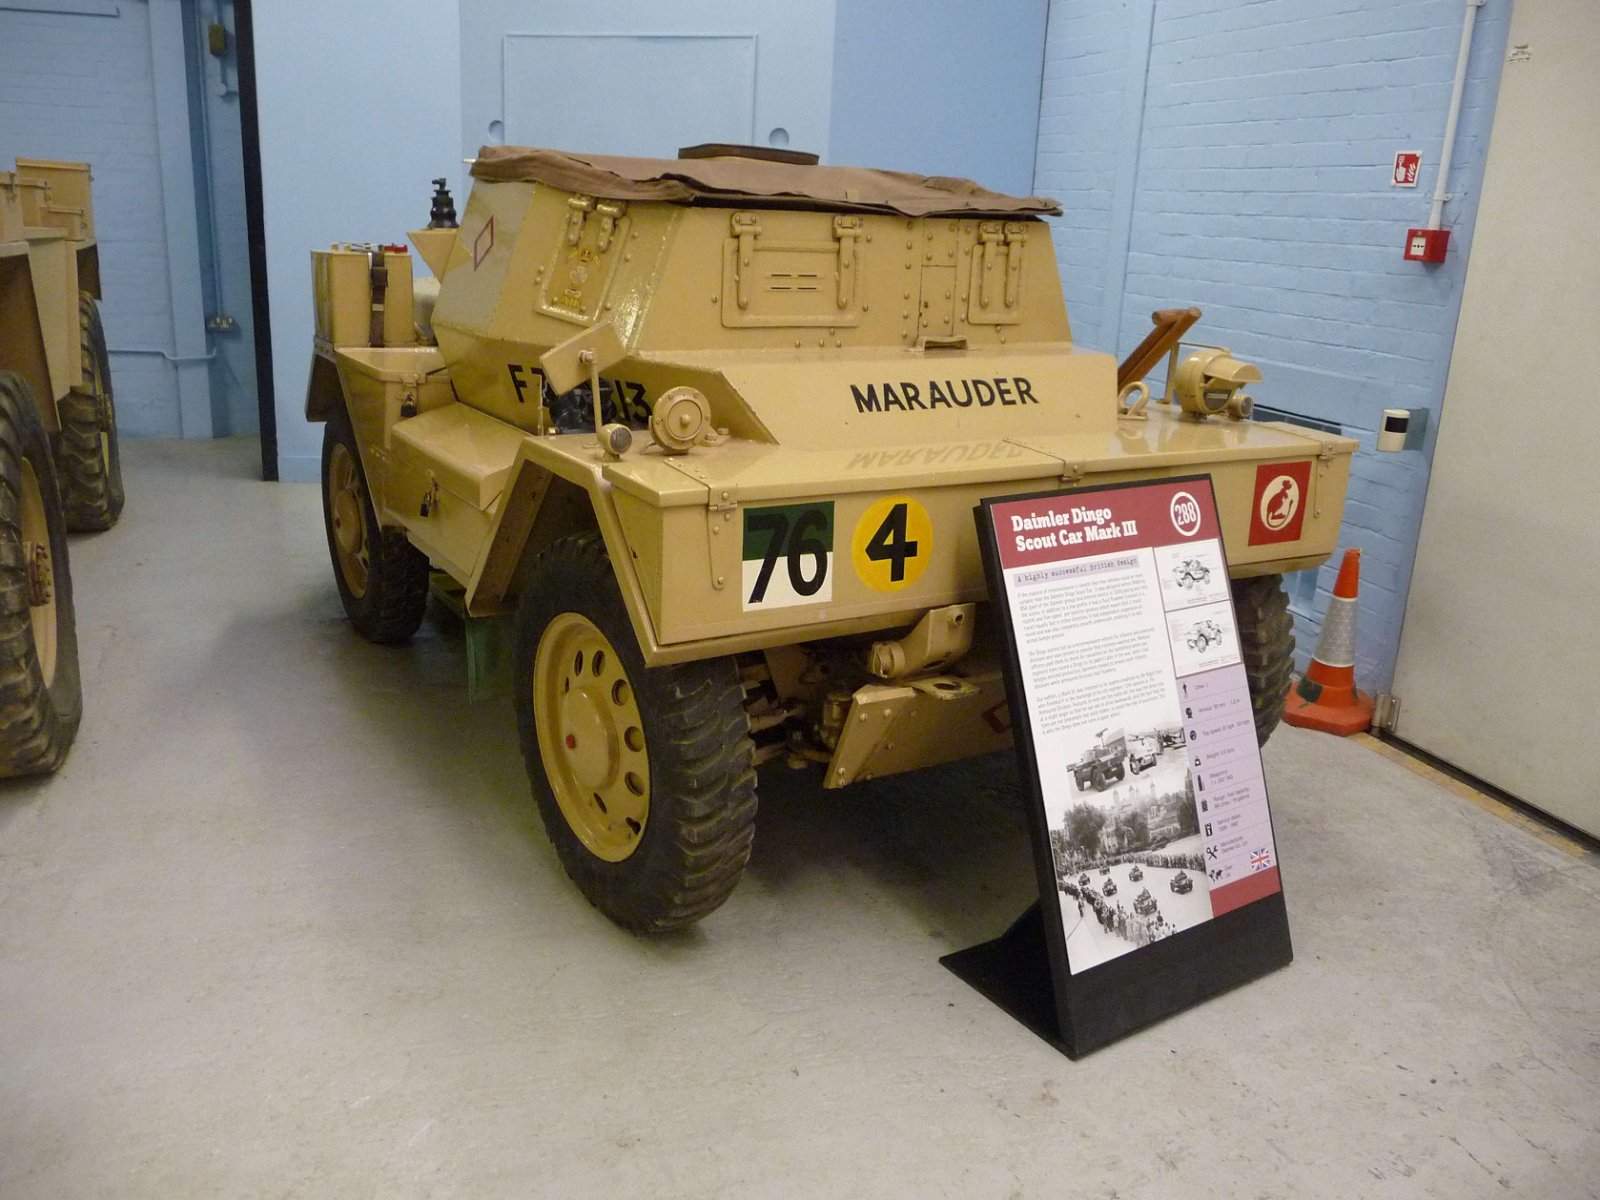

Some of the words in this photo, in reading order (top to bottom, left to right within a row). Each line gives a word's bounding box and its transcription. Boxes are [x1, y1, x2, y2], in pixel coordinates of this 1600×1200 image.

[850, 377, 1039, 413] MARAUDER
[1011, 510, 1070, 532] Daimler
[1070, 506, 1112, 525] Dingo
[1175, 501, 1197, 525] 288
[865, 503, 918, 582] 4
[1015, 532, 1058, 552] Scout
[1059, 529, 1083, 545] Car
[1084, 522, 1121, 542] Mark
[1121, 520, 1138, 536] III
[747, 509, 828, 604] 76
